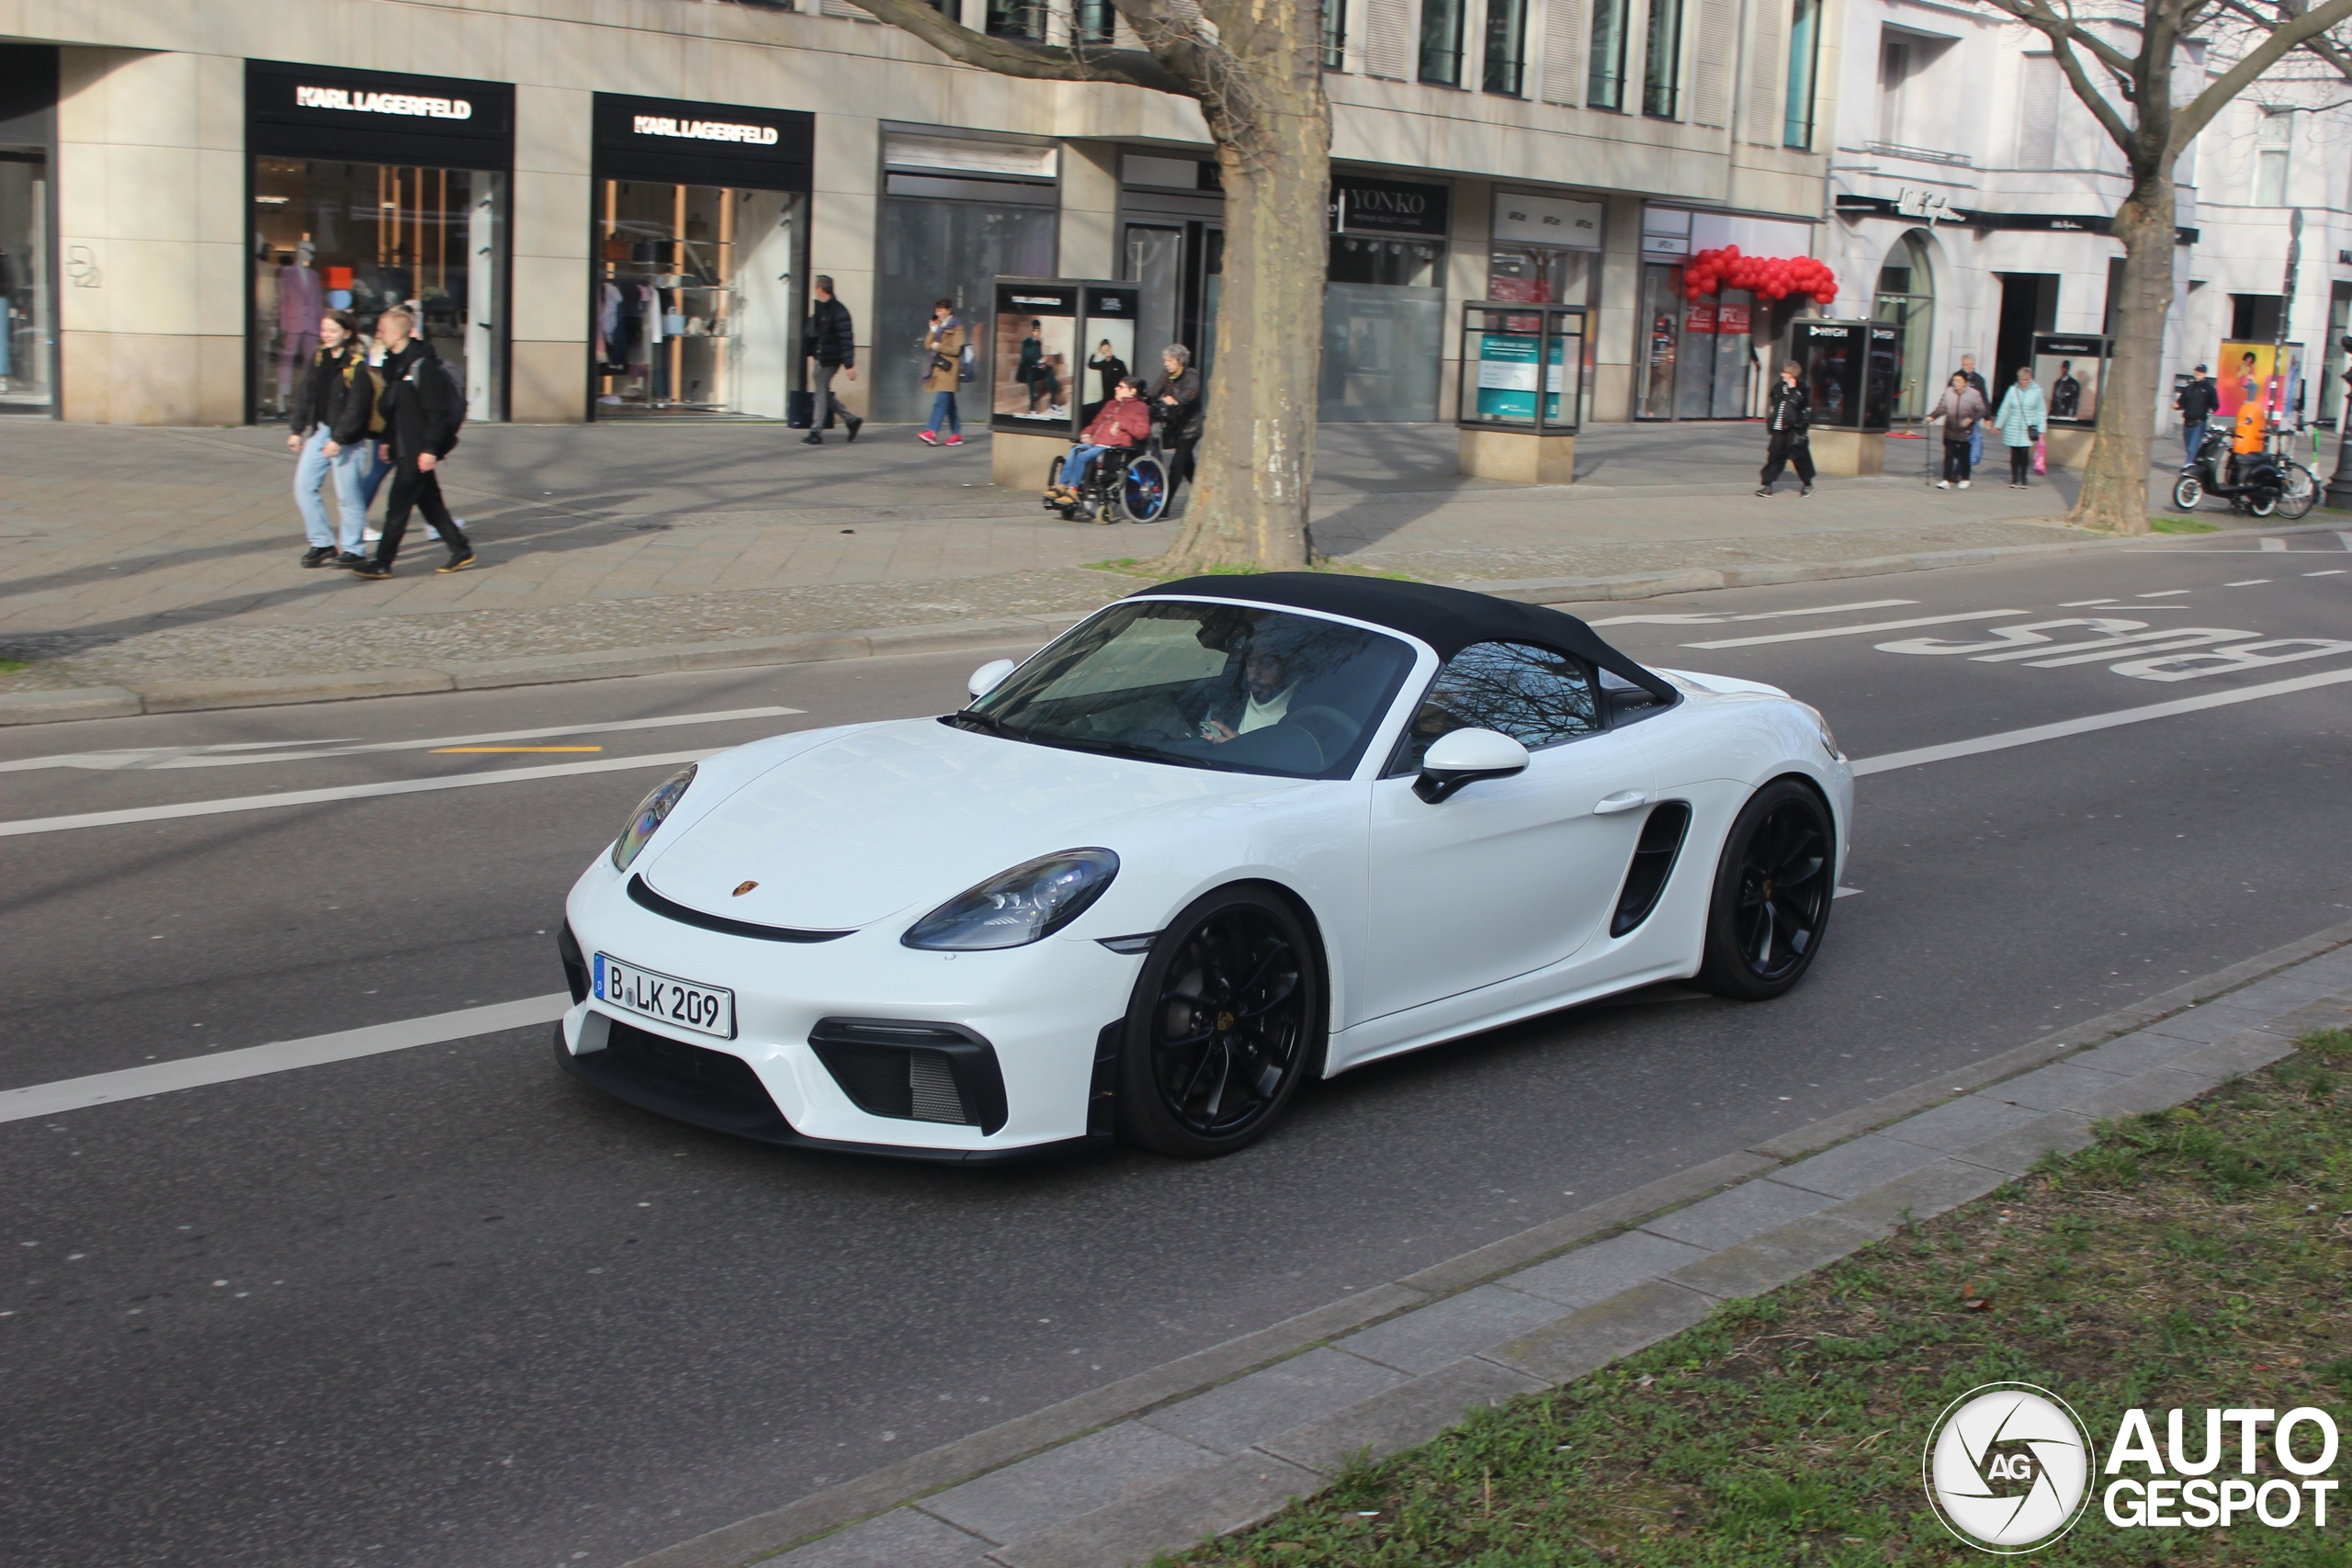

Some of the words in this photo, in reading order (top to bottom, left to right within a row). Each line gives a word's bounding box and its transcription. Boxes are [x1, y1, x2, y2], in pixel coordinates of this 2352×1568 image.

[296, 85, 354, 110] KARL
[354, 91, 472, 119] LAGERFELD
[633, 115, 681, 137] KARL
[681, 119, 779, 145] LAGERFELD
[1351, 188, 1426, 214] YONKO
[1873, 618, 2352, 682] BUS
[596, 980, 603, 991] D
[611, 965, 623, 1000] B
[637, 975, 664, 1016] LK
[672, 986, 718, 1028] 209
